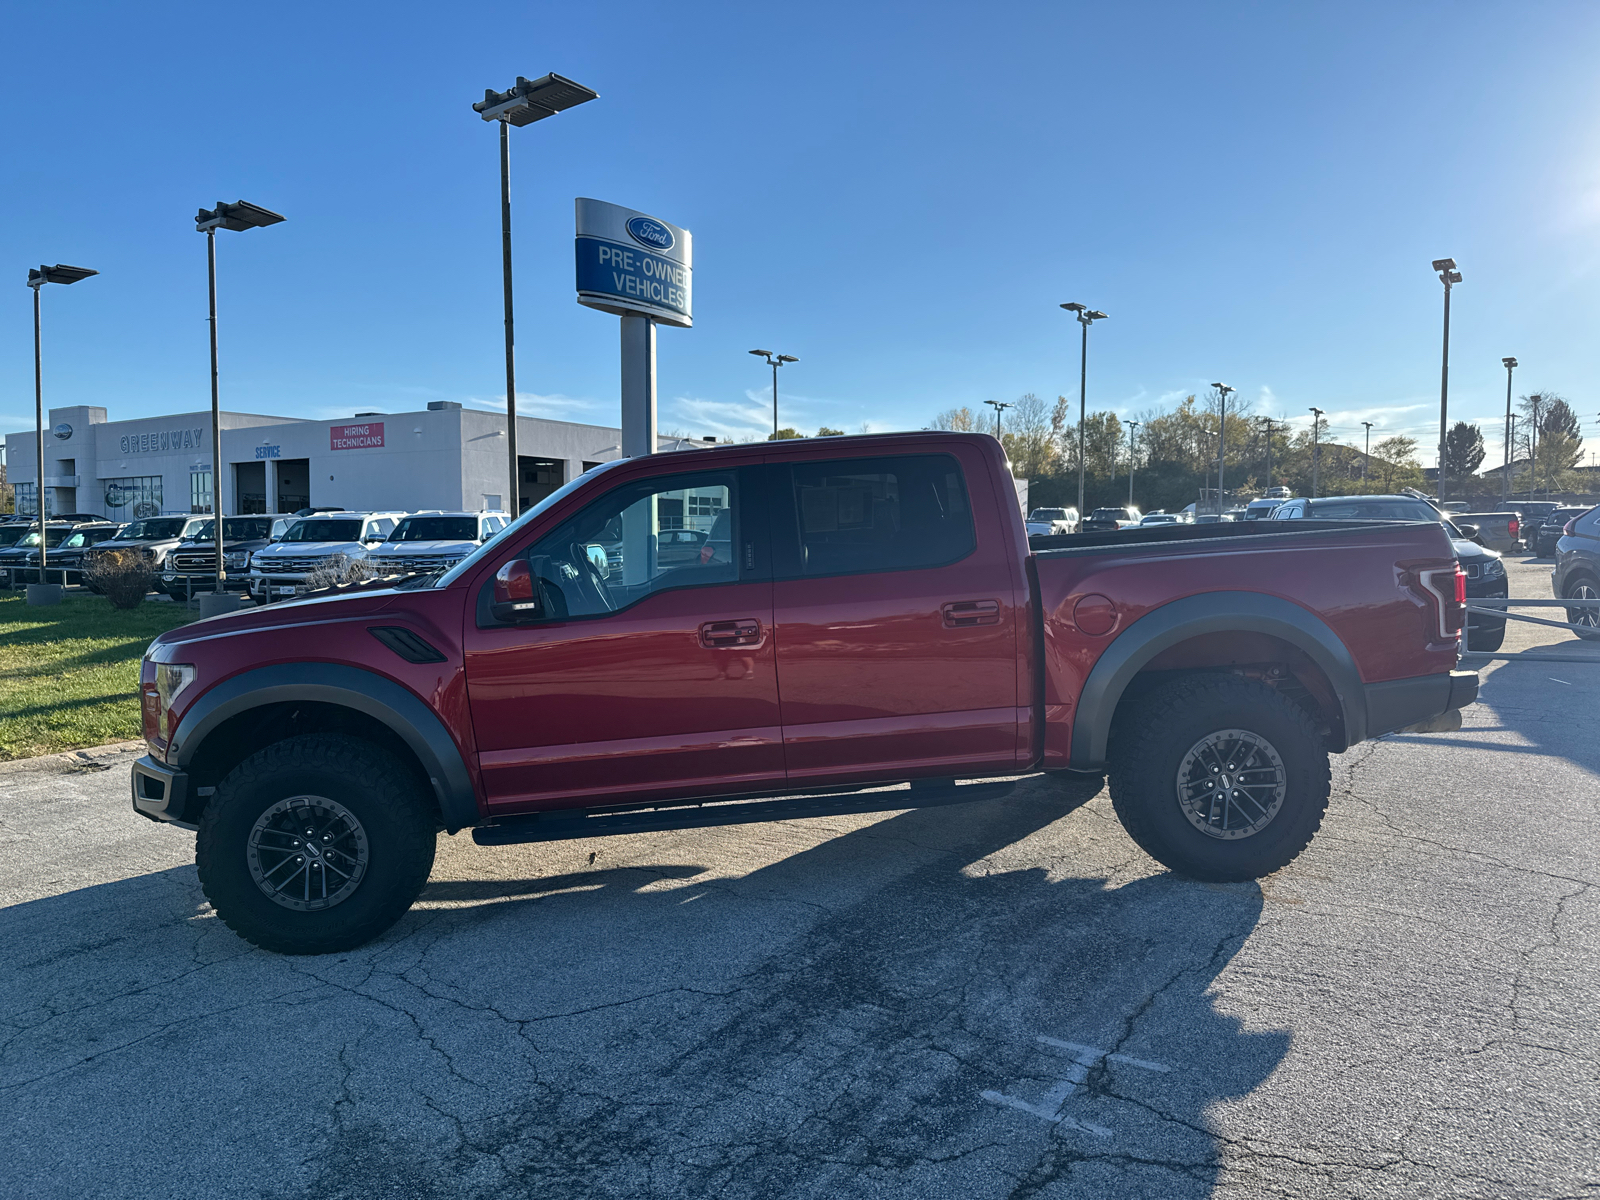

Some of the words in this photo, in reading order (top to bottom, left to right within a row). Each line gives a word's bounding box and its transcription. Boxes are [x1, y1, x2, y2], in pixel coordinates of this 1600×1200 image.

[640, 222, 667, 245] Ford
[612, 271, 684, 309] VEHICLES
[344, 425, 369, 437] HIRING
[120, 427, 203, 454] GREENWAY
[333, 436, 382, 448] TECHNICIANS
[255, 445, 281, 459] SERVICE
